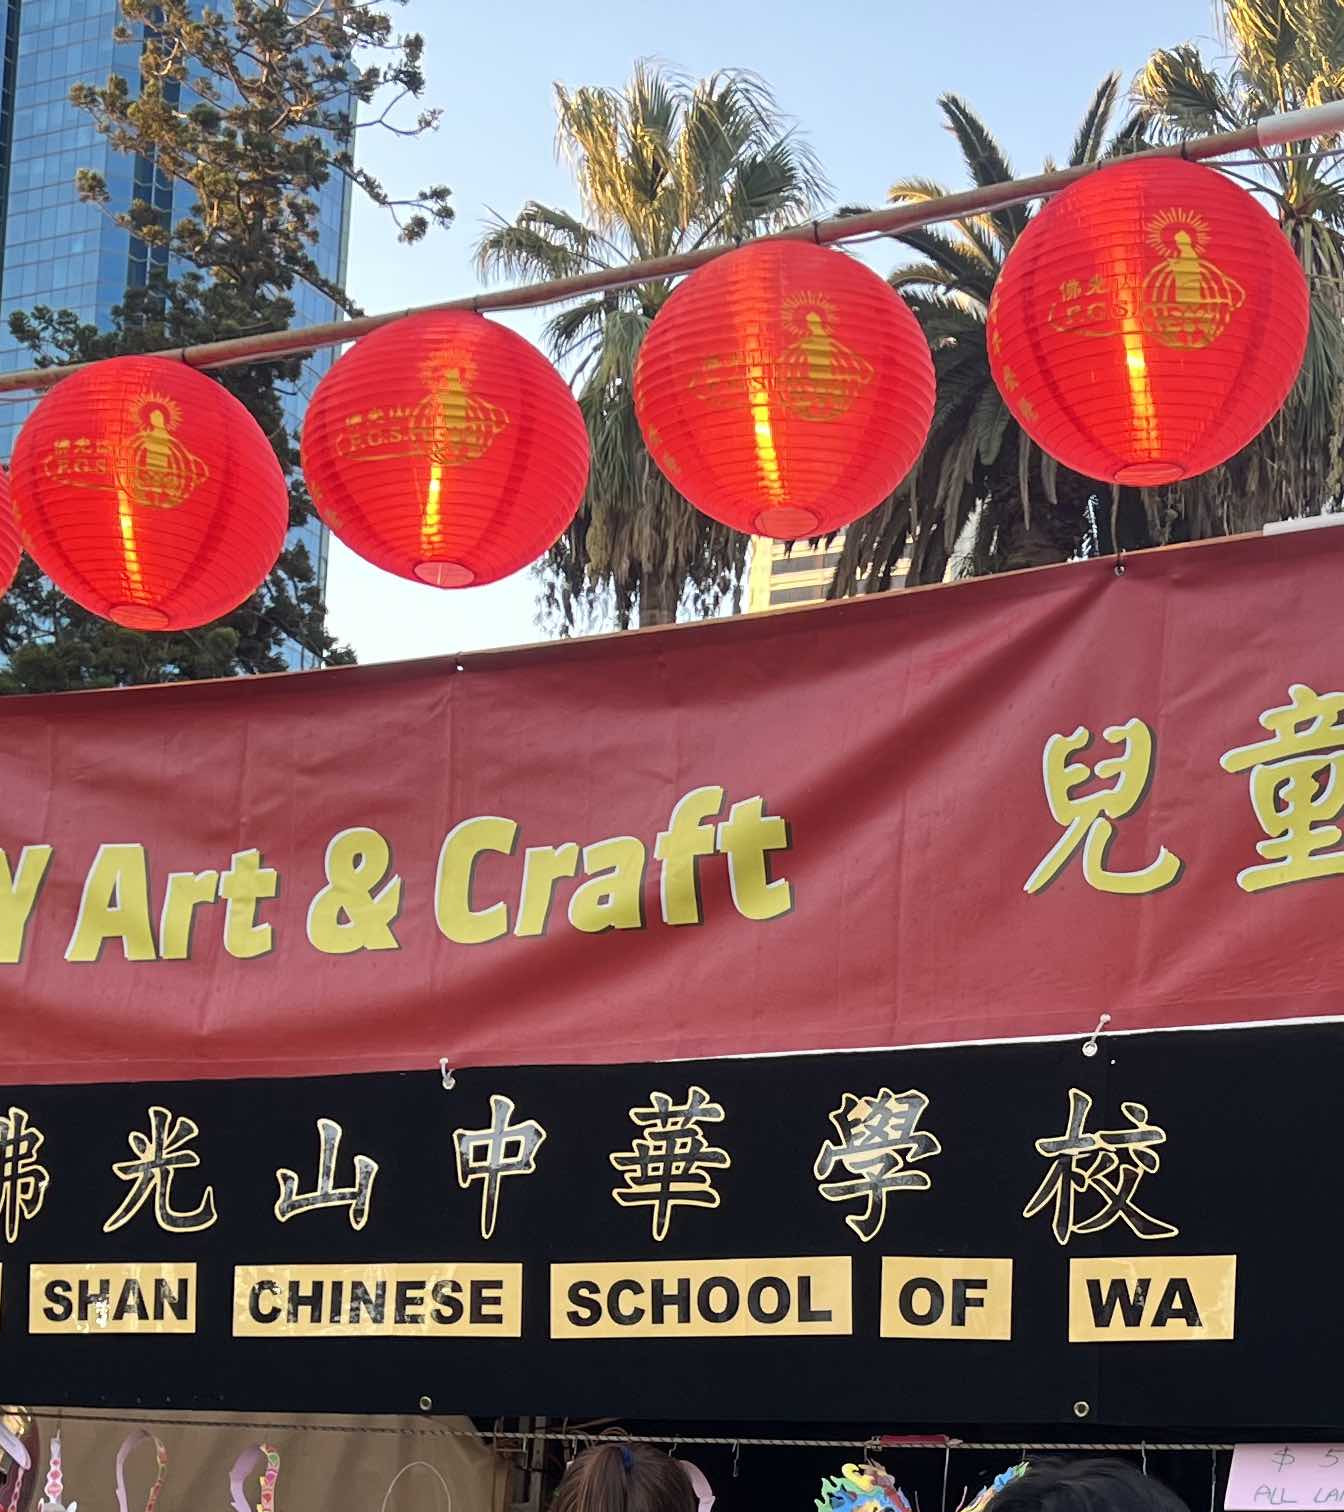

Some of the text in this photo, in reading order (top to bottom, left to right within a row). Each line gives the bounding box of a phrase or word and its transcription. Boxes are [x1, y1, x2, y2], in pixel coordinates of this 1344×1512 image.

[64, 842, 278, 962] Art
[305, 826, 401, 954] &
[433, 785, 792, 946] Craft
[43, 1278, 189, 1322] SHAN
[247, 1278, 504, 1325] CHINESE
[565, 1275, 832, 1327] SCHOOL
[897, 1277, 989, 1327] OF
[1086, 1277, 1204, 1328] WA
[1253, 1484, 1297, 1506] ALL
